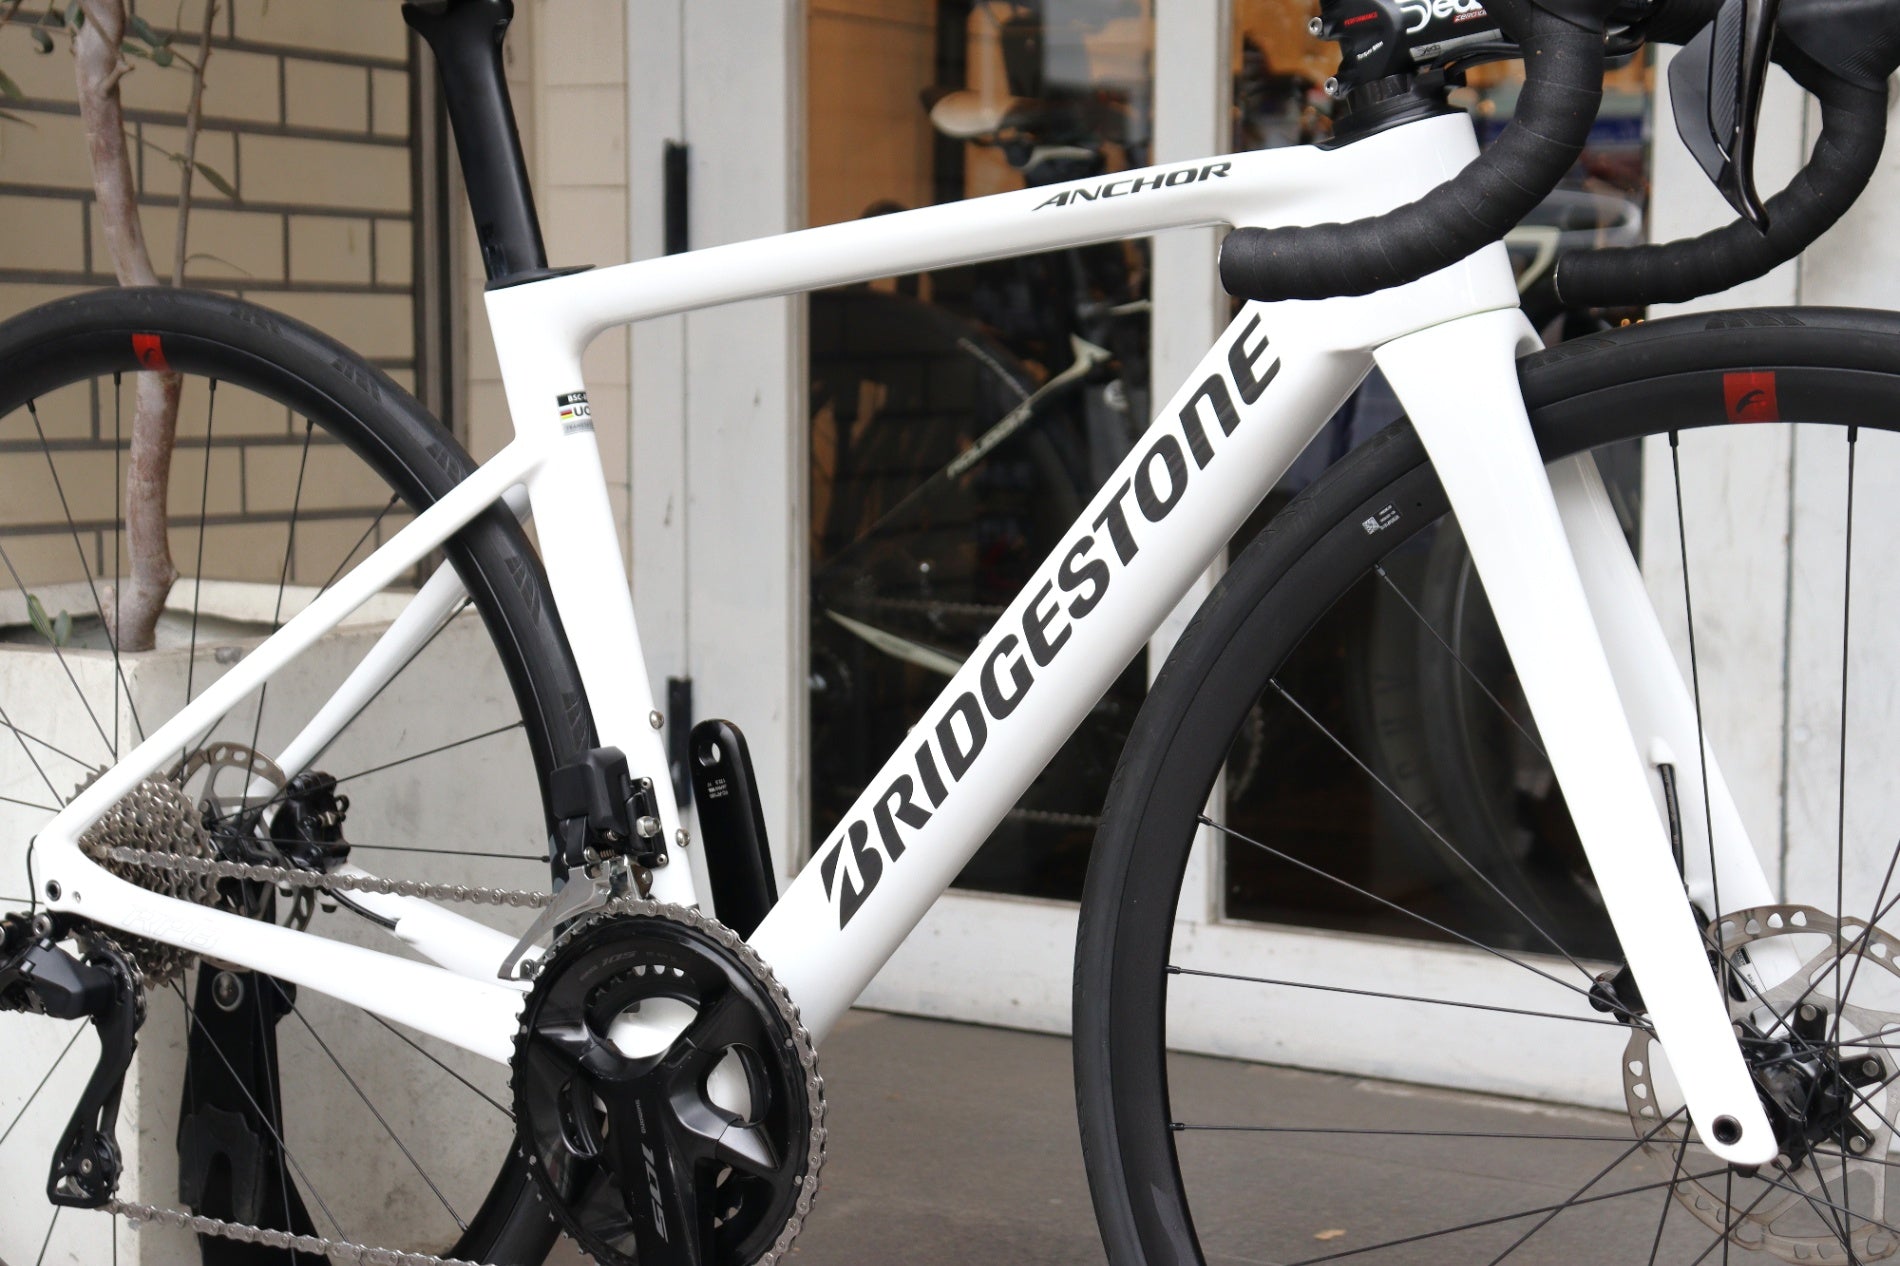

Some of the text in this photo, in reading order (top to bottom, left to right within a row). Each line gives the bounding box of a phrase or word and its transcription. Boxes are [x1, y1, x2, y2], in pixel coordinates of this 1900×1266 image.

[1032, 162, 1232, 211] ANCHOR
[820, 312, 1282, 931] BRIDGESTONE
[641, 1142, 669, 1243] 105
